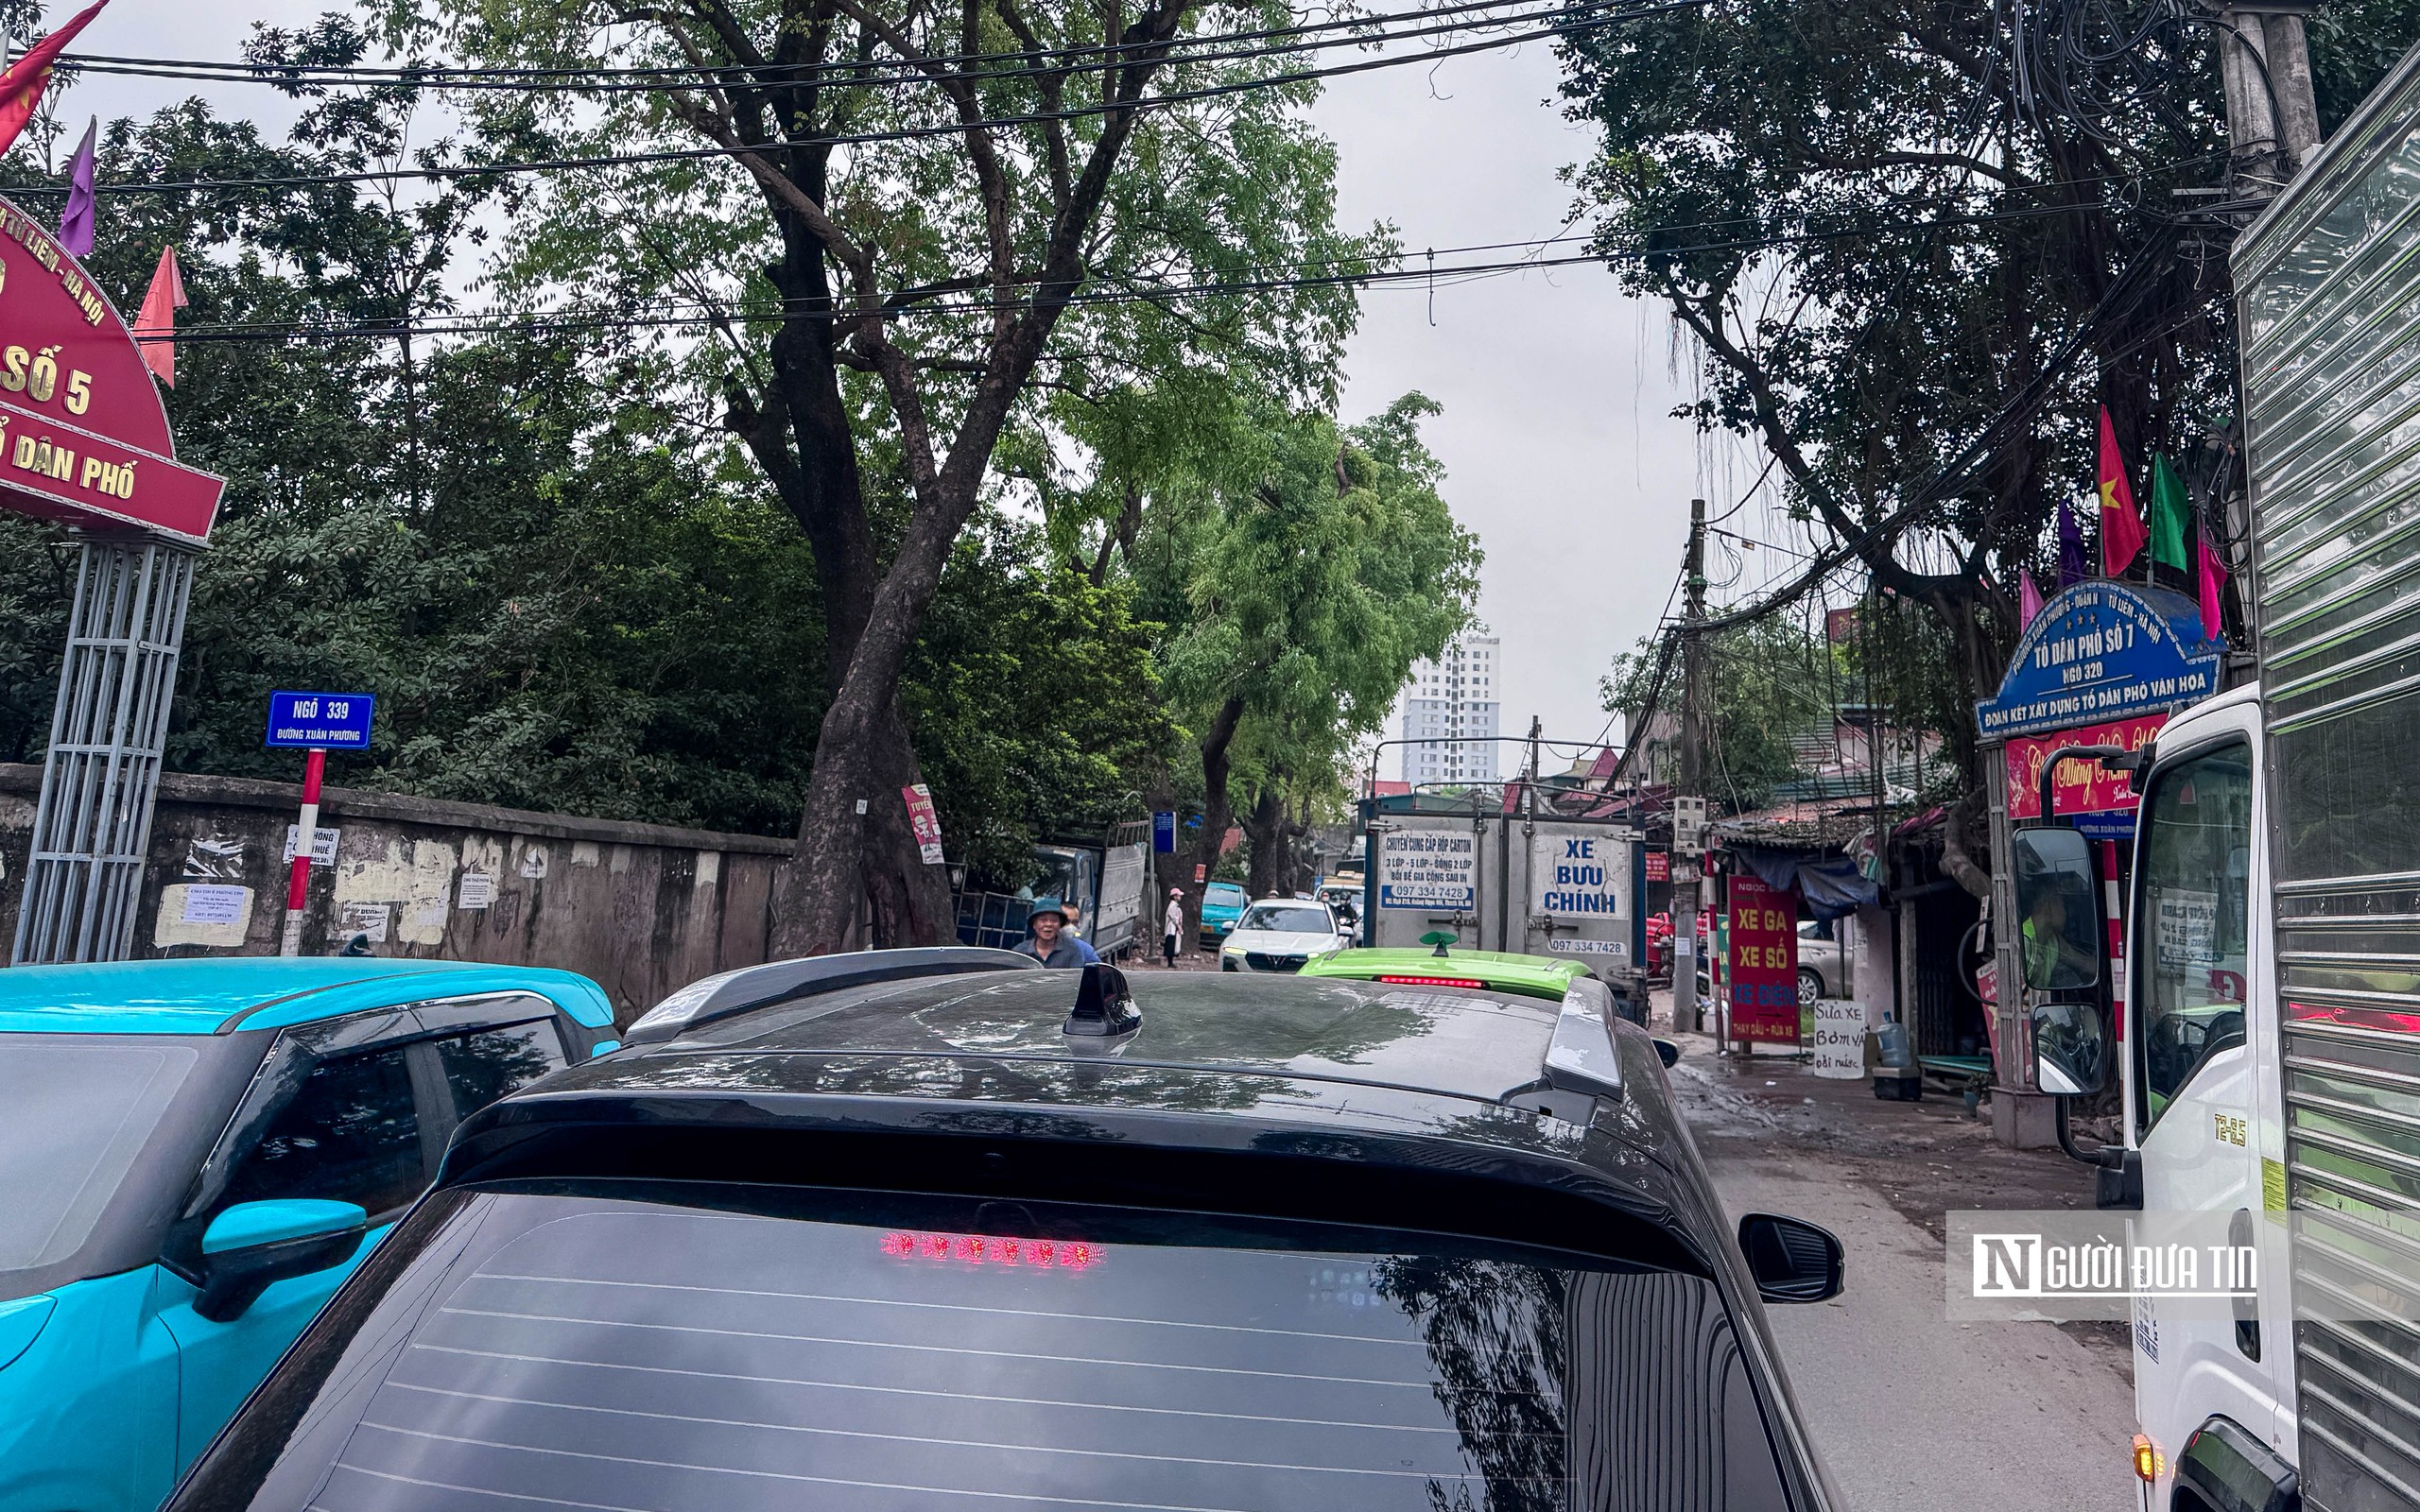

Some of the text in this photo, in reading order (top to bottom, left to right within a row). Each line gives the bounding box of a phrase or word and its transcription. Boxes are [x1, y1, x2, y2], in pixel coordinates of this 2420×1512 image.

[23, 229, 60, 273] LIÊM
[61, 269, 83, 301] HÀ
[78, 289, 105, 327] NỘI
[0, 345, 93, 416] SỐ 5
[12, 435, 75, 482] DÂN
[79, 460, 138, 499] PHỐ
[2105, 618, 2123, 653] SỐ
[2125, 624, 2134, 648] 7
[2084, 662, 2102, 680] 320
[293, 697, 349, 720] NGÕ 339
[2010, 703, 2028, 722] KẾT
[277, 727, 360, 741] ĐƯỜNG XUÂN PHƯƠNG
[1450, 838, 1472, 853] CARTON
[1565, 839, 1595, 859] XE
[1387, 858, 1392, 868] 3
[1410, 858, 1415, 868] 5
[1454, 860, 1459, 869] 2
[1413, 871, 1426, 882] GIA
[1445, 873, 1459, 883] SAU
[1460, 873, 1467, 884] IN
[1396, 885, 1463, 898] 097 334 7428
[1544, 888, 1616, 913] CHÍNH
[1737, 908, 1789, 932] XE GA
[1552, 940, 1622, 954] 097 334 7428
[1738, 945, 1760, 968] XE
[1765, 936, 1788, 970] SỐ
[1733, 983, 1754, 1005] XE
[1845, 1007, 1862, 1021] XE
[1733, 1022, 1750, 1035] THAY
[1784, 1025, 1793, 1037] XE
